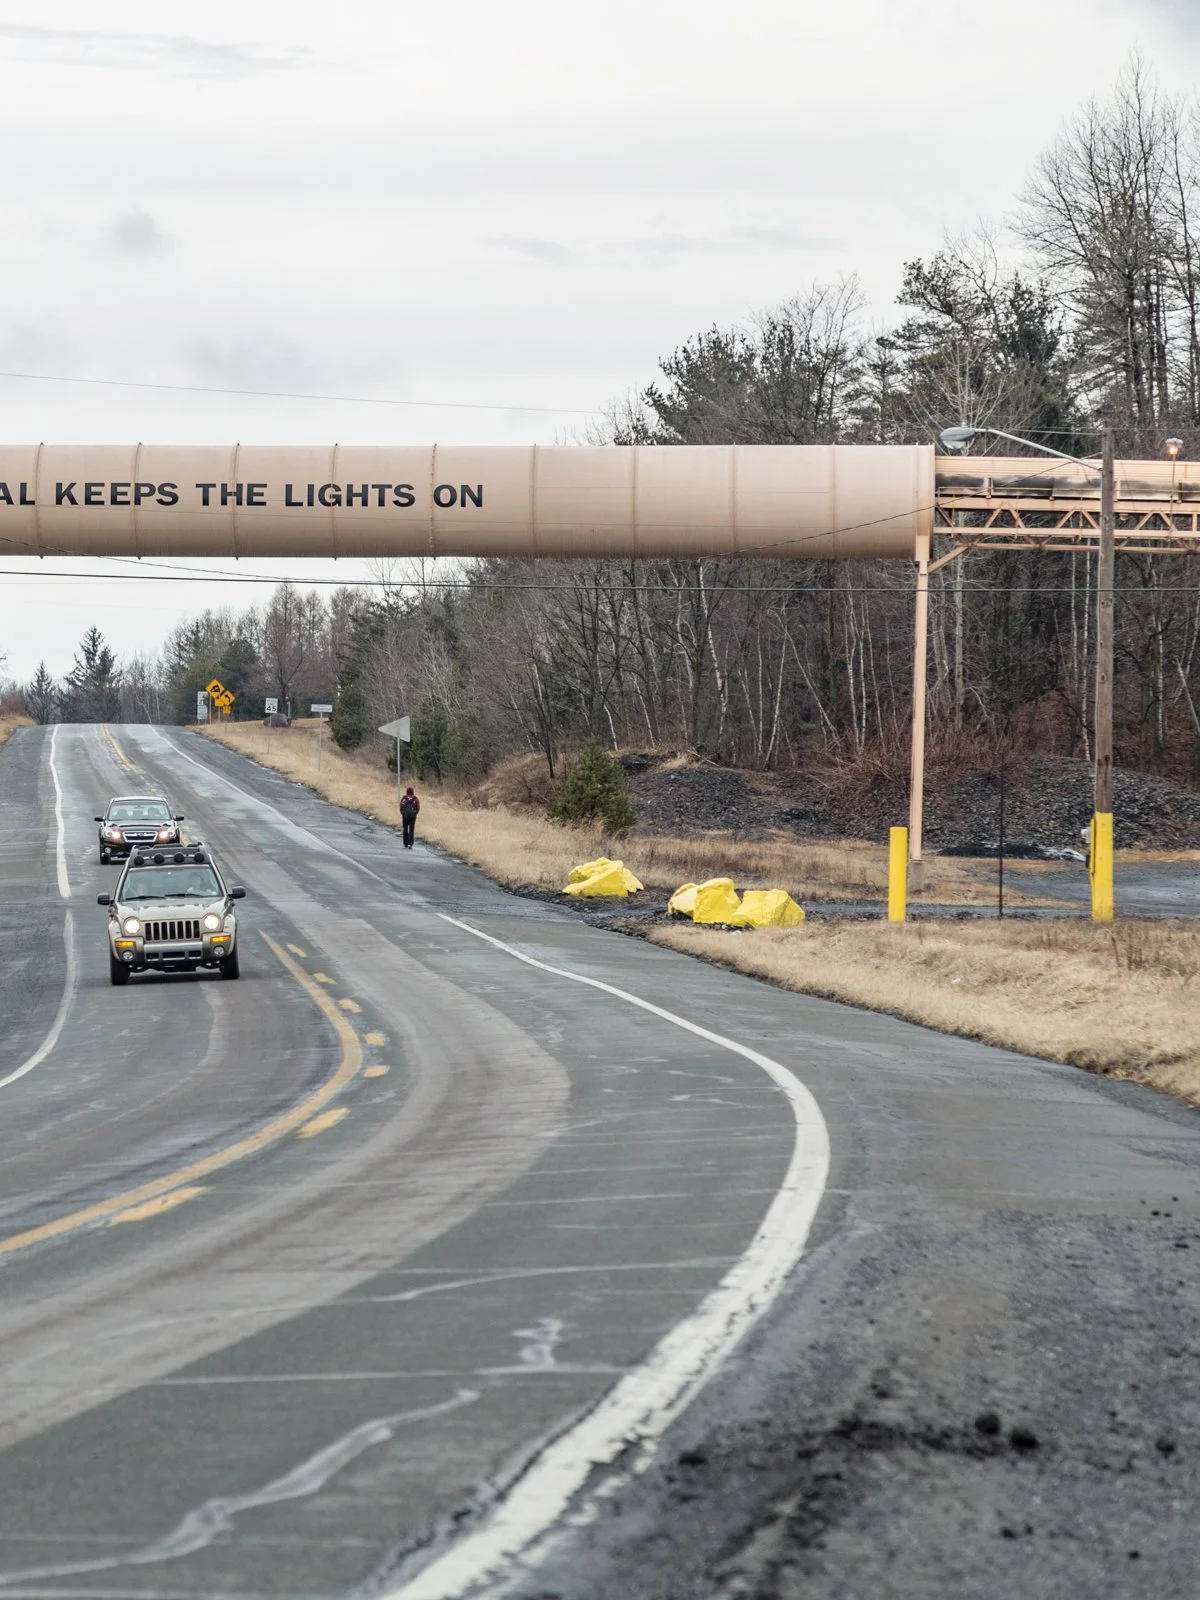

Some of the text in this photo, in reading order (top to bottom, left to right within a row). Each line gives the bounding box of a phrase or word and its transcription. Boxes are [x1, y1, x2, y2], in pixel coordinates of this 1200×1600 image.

[55, 482, 179, 507] KEEPS
[195, 483, 268, 507] THE
[285, 483, 416, 508] LIGHTS
[433, 484, 484, 508] ON
